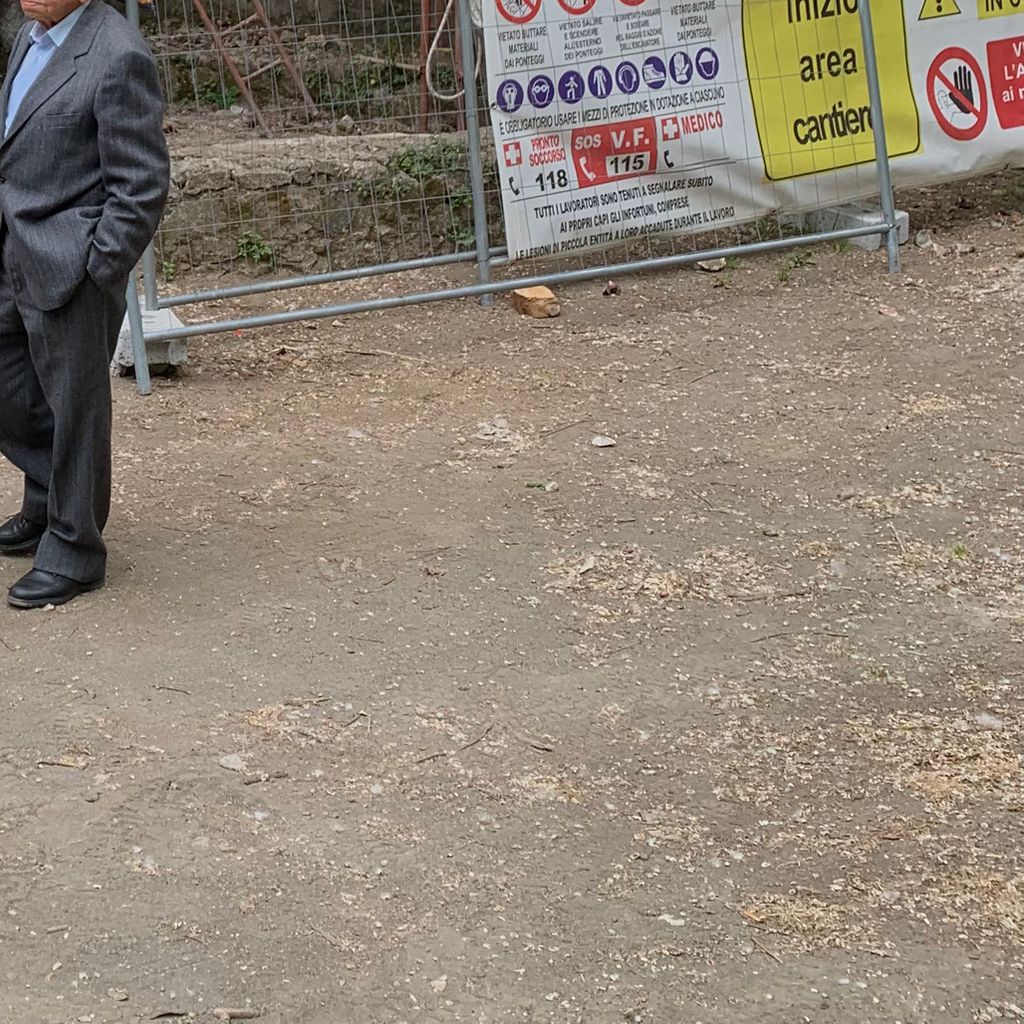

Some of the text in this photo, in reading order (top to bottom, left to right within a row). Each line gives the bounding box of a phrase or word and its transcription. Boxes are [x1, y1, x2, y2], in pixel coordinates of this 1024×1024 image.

[498, 26, 548, 42] VIETATO BUTTARE
[508, 42, 538, 54] MATERIALI
[505, 54, 545, 70] DAI PONTEGGI
[800, 47, 858, 82] area
[1002, 86, 1014, 103] ai
[506, 116, 553, 132] OBBLIGATORIO
[555, 112, 577, 126] USARE
[582, 110, 602, 123] MEZZI
[610, 102, 650, 120] PROTEZIONE
[656, 94, 690, 112] DOTAZIONE
[694, 87, 725, 104] CIASCUNO
[681, 110, 724, 135] MEDICO
[530, 134, 560, 150] PRONTO
[574, 127, 650, 150] SOS V.F.
[529, 148, 566, 167] SOCCORSO
[610, 154, 644, 174] 115
[535, 169, 568, 192] 118
[534, 204, 555, 219] TUTTI
[560, 196, 600, 214] LAVORATORI
[601, 192, 618, 206] SONO
[619, 188, 642, 203] TENUTI
[642, 186, 648, 198] A
[648, 180, 686, 196] SEGNALARE
[688, 176, 714, 188] SUBITO
[560, 221, 568, 234] AI
[568, 215, 593, 232] PROPRI
[594, 212, 610, 228] CAPI
[610, 209, 621, 224] GLI
[657, 196, 690, 212] COMPRESE
[525, 244, 552, 258] LESIONI
[552, 242, 560, 254] DI
[561, 236, 588, 252] PICCOLA
[613, 230, 620, 241] A
[620, 226, 638, 239] LORO
[639, 220, 674, 236] ACCADUTE
[674, 212, 702, 230] DURANTE
[702, 212, 710, 222] IL
[710, 206, 736, 222] LAVORO
